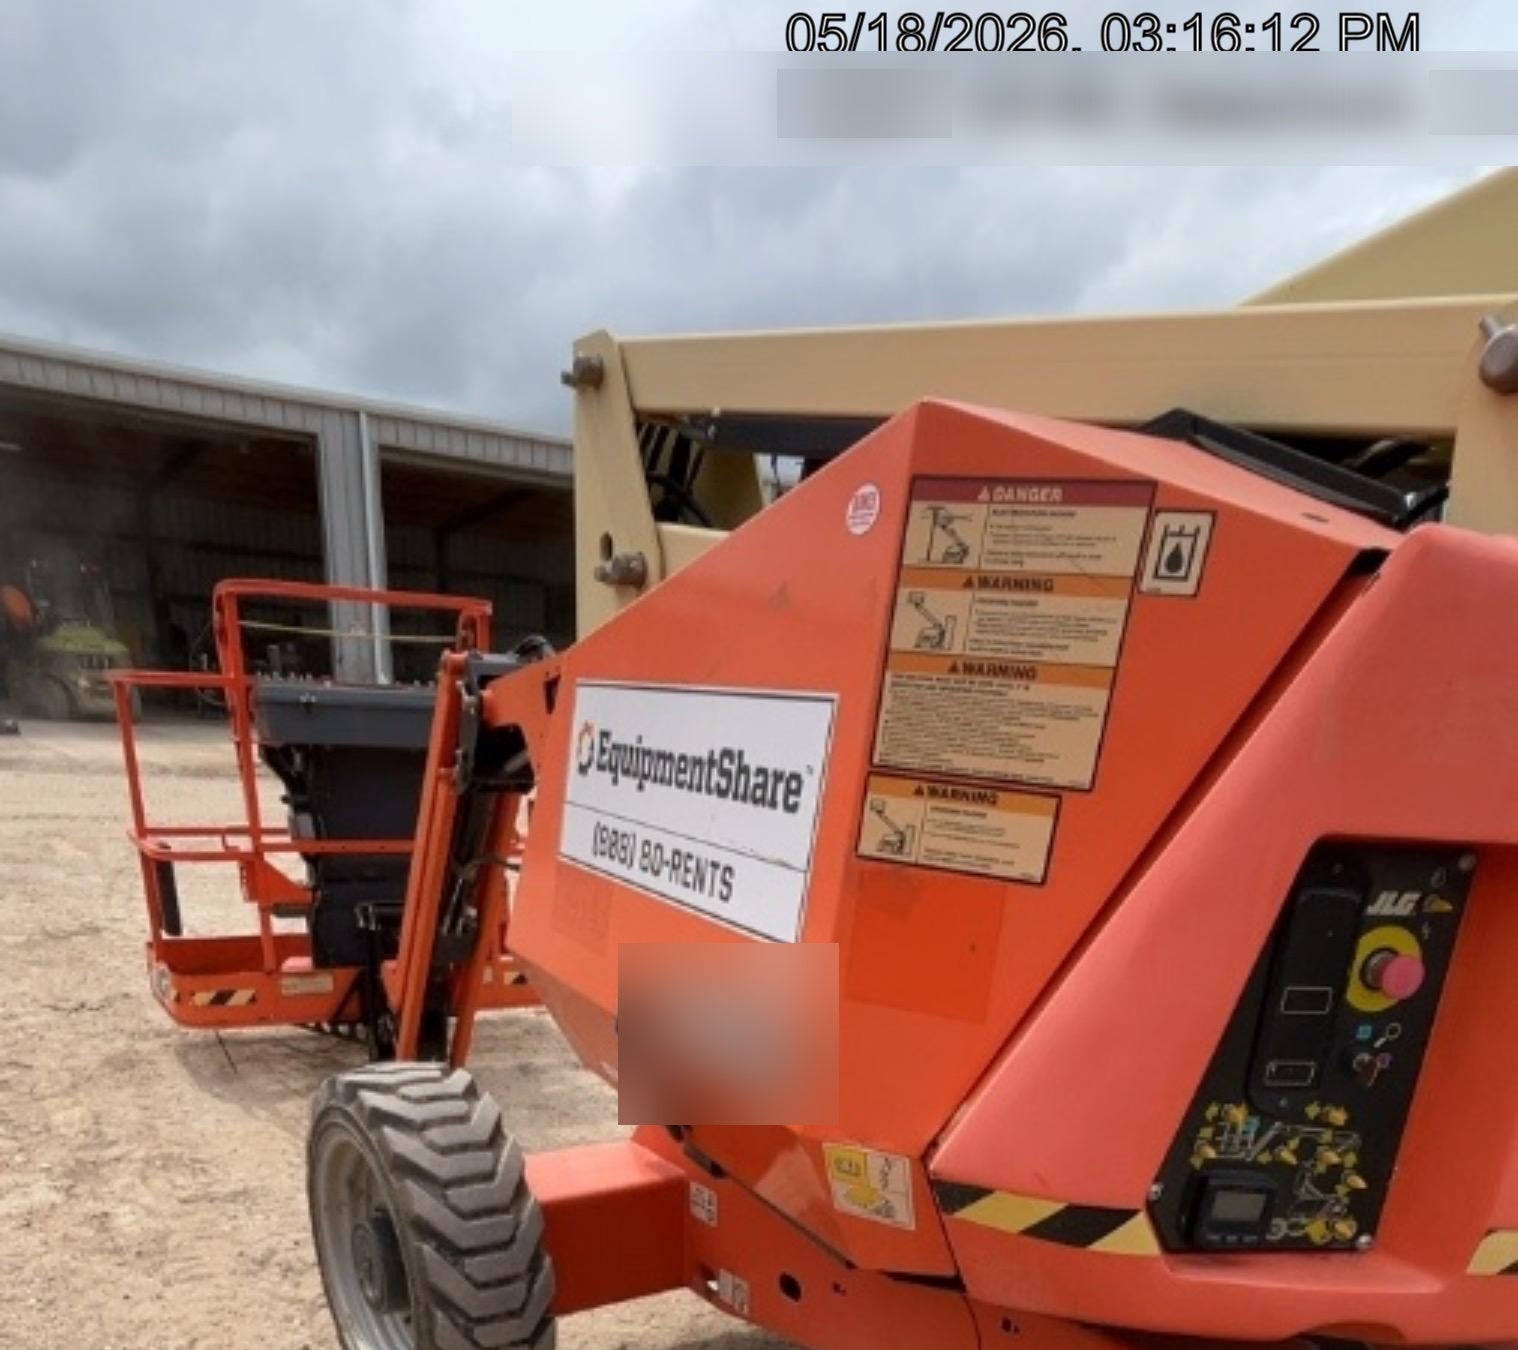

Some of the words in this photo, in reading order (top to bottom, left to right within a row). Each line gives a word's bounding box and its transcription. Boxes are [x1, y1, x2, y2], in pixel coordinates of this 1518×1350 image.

[992, 484, 1063, 502] DANGER
[976, 575, 1055, 593] WARNING
[962, 660, 1037, 682] WARNING
[596, 729, 804, 814] EquipmentShare
[926, 784, 998, 807] WARNING
[639, 838, 736, 904] 80-RENTS
[1366, 890, 1421, 917] JLG
